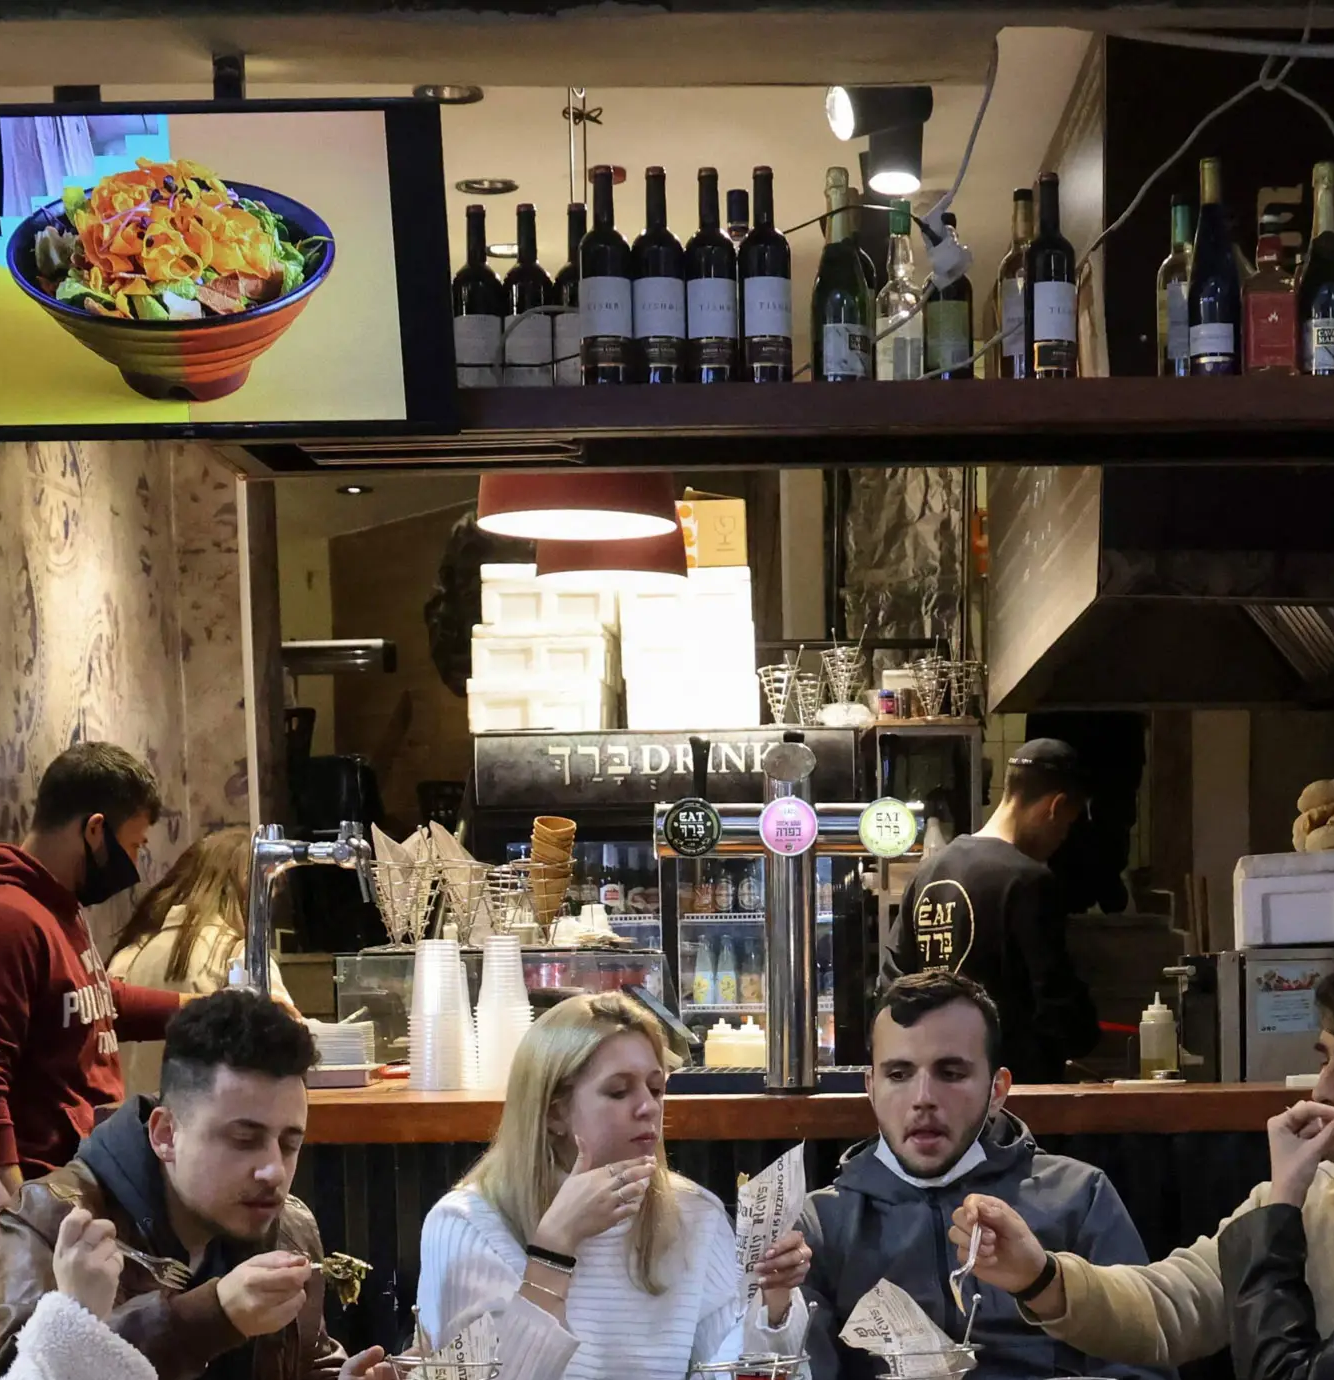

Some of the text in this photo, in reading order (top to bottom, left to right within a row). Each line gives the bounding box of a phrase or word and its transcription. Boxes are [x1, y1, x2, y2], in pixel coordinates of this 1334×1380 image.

[679, 811, 705, 822] EAT
[776, 827, 802, 837] כפרה
[774, 1174, 785, 1217] FIZZLING
